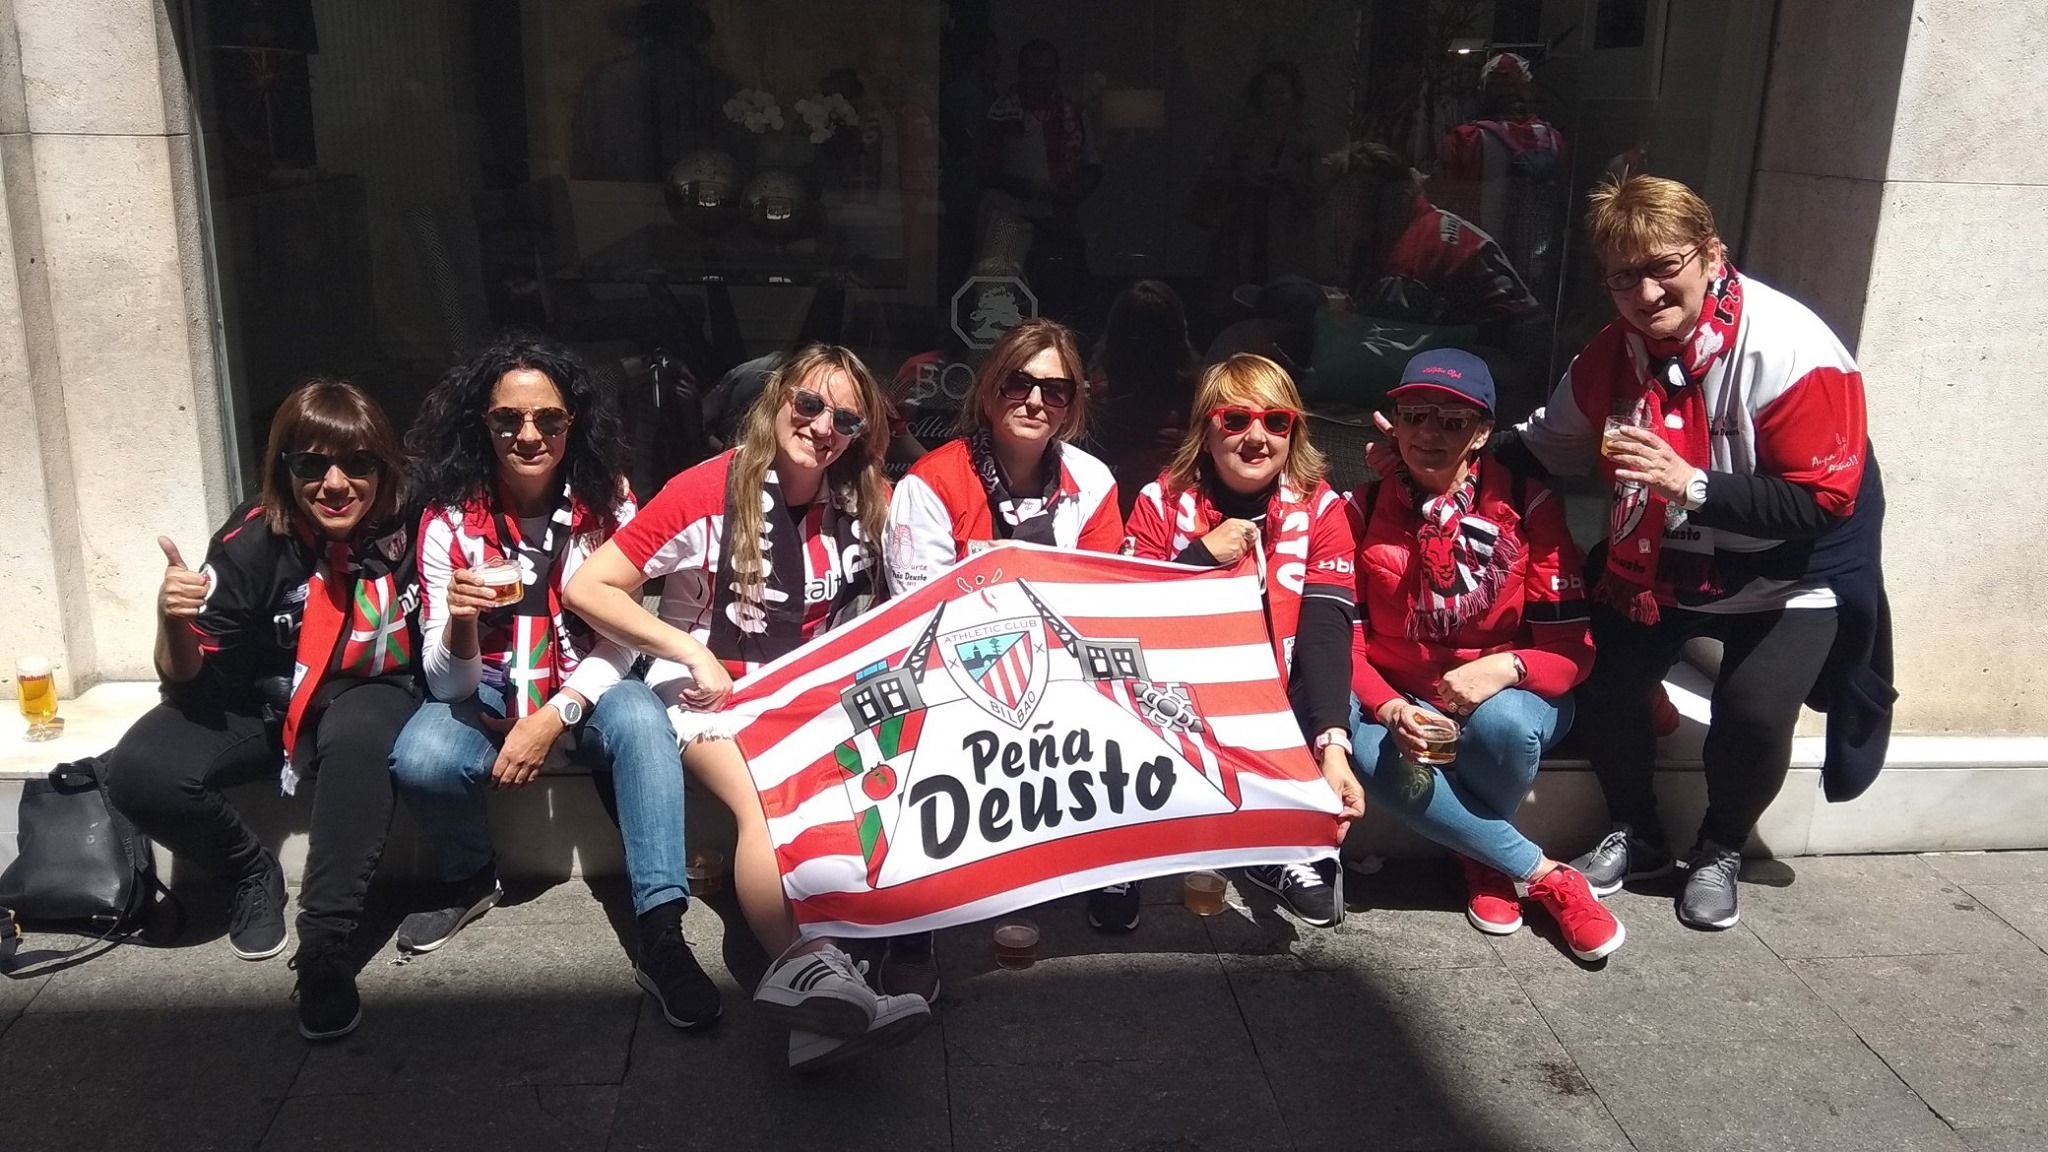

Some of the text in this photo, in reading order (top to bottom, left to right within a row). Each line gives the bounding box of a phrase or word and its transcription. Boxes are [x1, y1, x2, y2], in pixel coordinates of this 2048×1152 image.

[943, 619, 1038, 644] ATHLETIC CLUB
[989, 690, 1036, 724] BILBAO
[962, 720, 1095, 786] Peña
[908, 738, 1178, 860] Deusto
